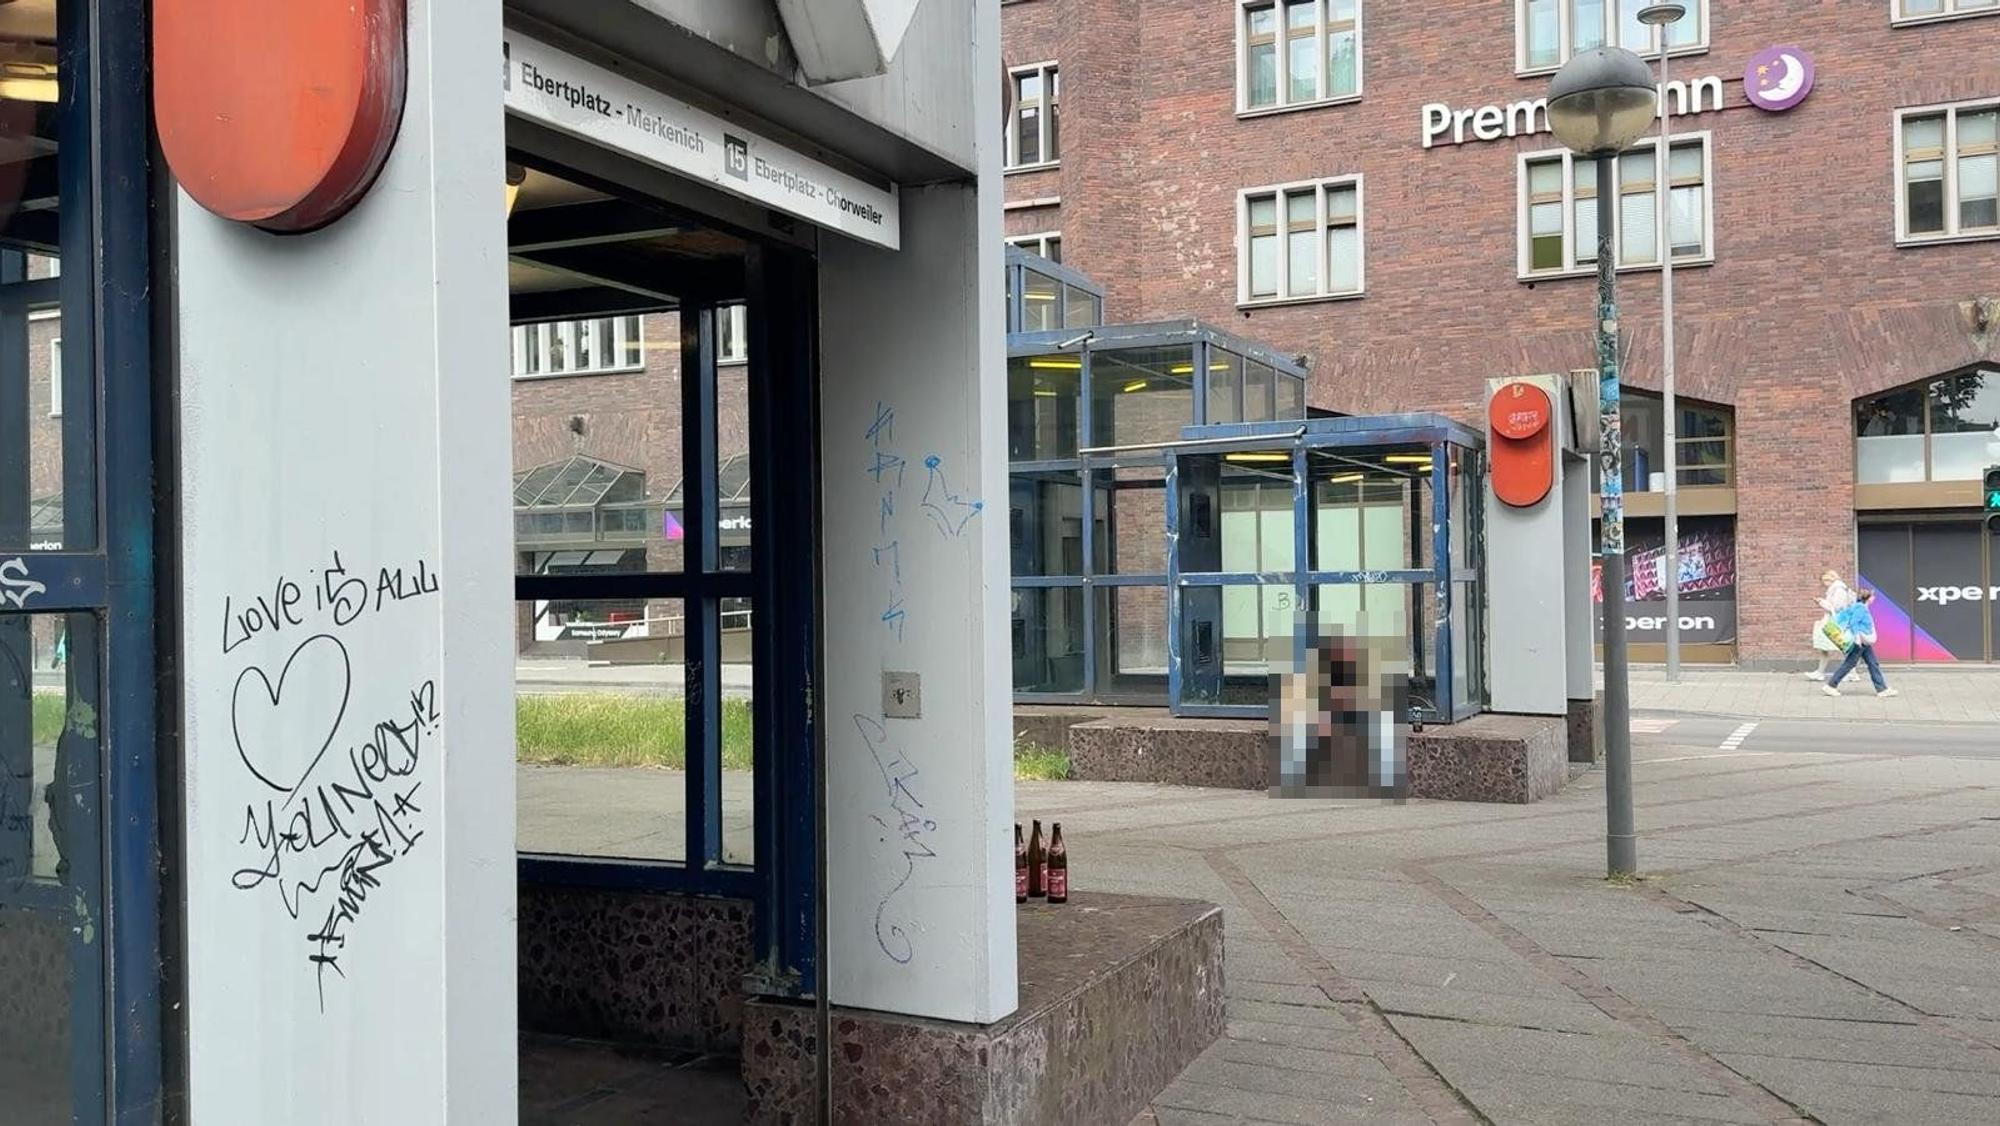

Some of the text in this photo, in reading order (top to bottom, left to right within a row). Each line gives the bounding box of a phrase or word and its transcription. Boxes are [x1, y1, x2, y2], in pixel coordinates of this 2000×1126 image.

[521, 62, 611, 117] Ebertplatz
[626, 104, 704, 153] Merkenich
[1421, 75, 1725, 149] Prem nn
[725, 142, 745, 173] 15
[754, 157, 816, 201] Ebertplatz
[826, 187, 883, 226] Chorweiler
[376, 560, 440, 612] ALL
[1600, 616, 1716, 630] eron
